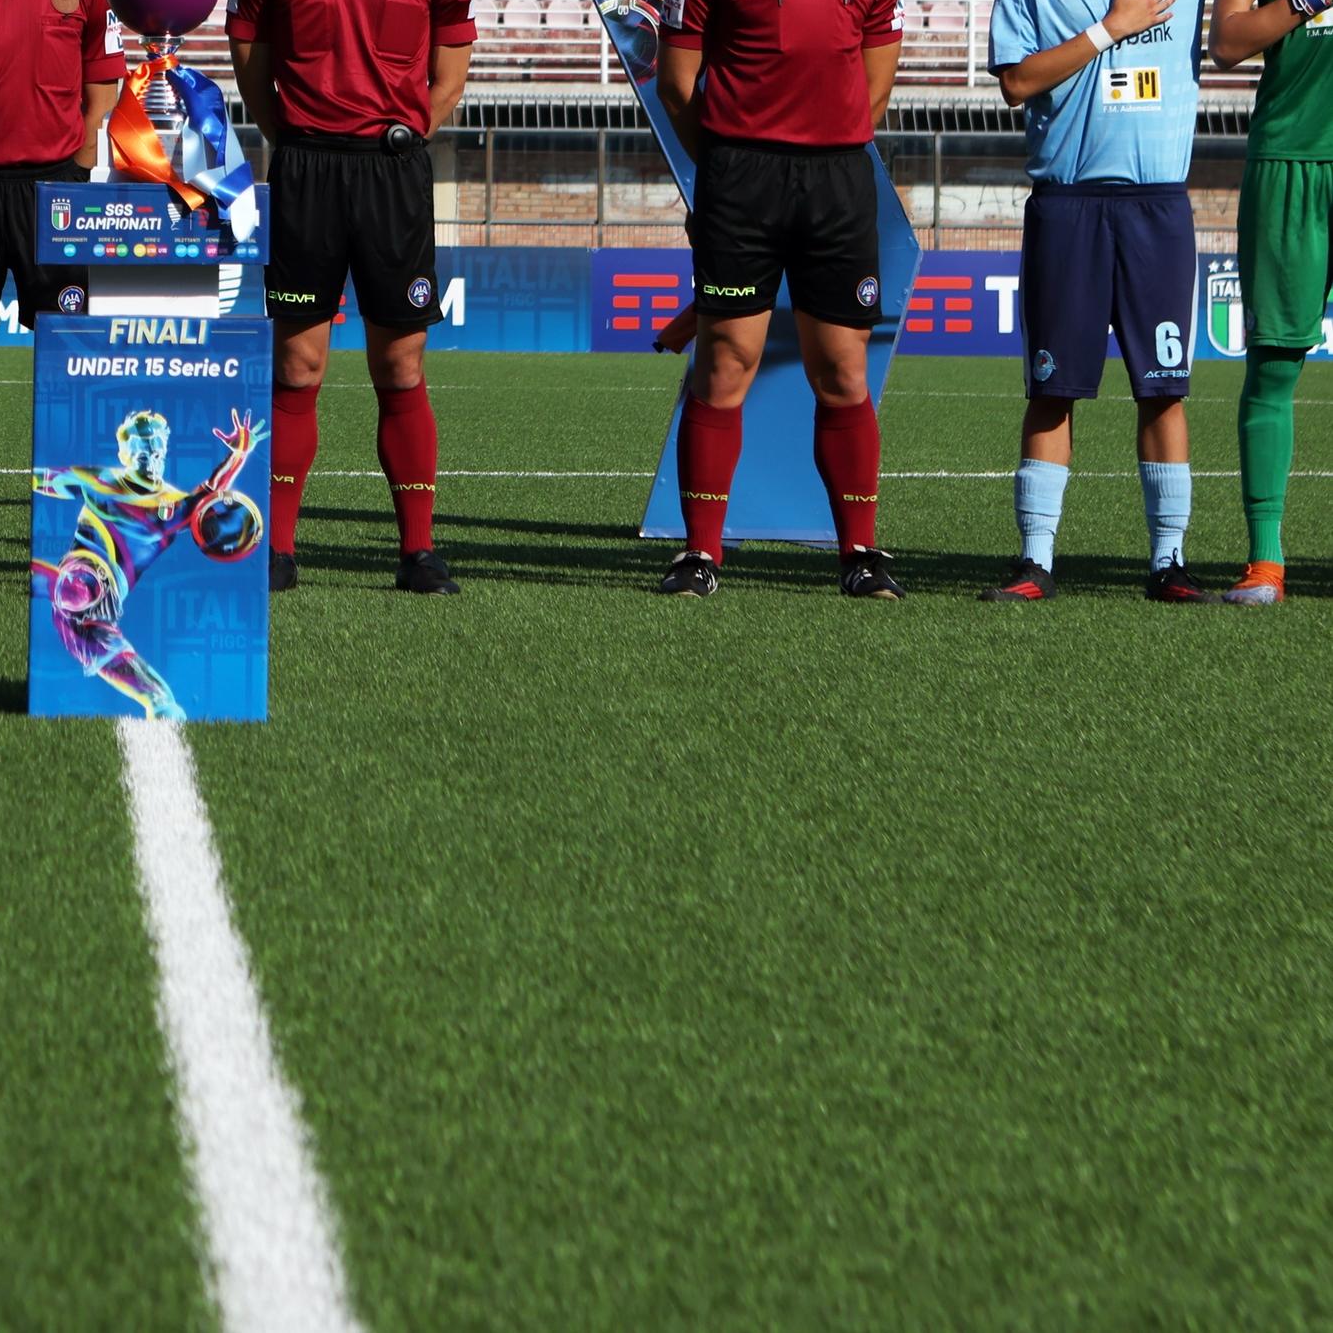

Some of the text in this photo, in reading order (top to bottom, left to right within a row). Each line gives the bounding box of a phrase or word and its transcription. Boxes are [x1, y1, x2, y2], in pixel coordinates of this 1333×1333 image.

[105, 203, 134, 216] SGS
[76, 217, 162, 231] CAMPIONATI
[413, 285, 429, 297] AIA
[703, 284, 756, 298] GIVOVA
[862, 285, 876, 297] AIA
[1212, 281, 1242, 297] ITAL
[64, 293, 81, 304] AIA
[268, 290, 315, 303] GVOVA
[109, 319, 207, 345] FINALI
[1155, 321, 1183, 367] 6
[67, 357, 139, 377] UNDER
[145, 357, 165, 377] 15
[168, 357, 221, 377] Serie
[223, 358, 239, 377] C
